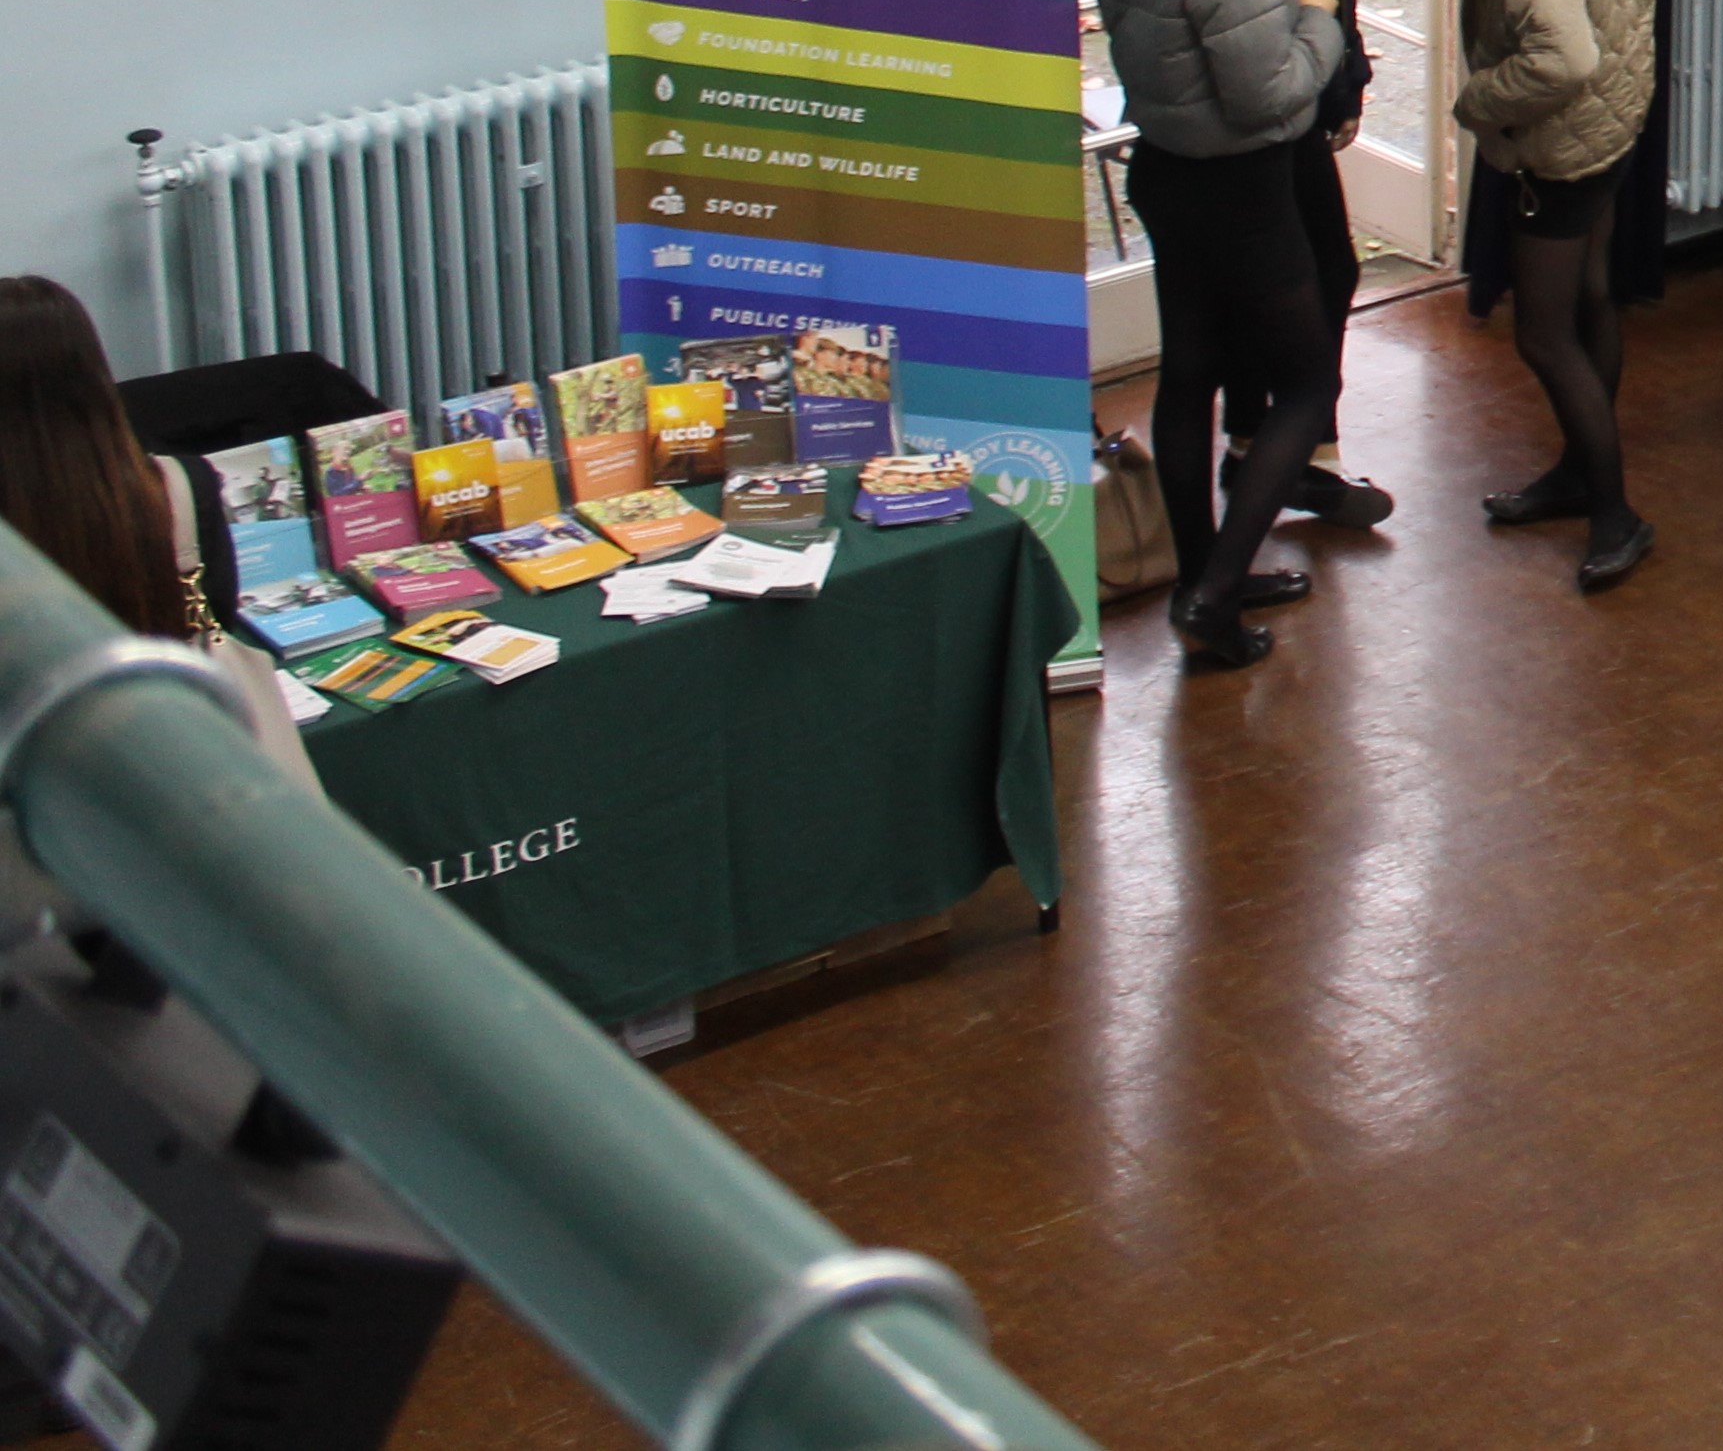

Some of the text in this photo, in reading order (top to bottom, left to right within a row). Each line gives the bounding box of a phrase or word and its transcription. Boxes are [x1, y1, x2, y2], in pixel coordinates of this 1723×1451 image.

[698, 32, 953, 79] FOUNDATION LEARNING
[700, 89, 866, 124] HORTICULTURE
[703, 143, 920, 182] LAND AND WILDLIFE
[705, 198, 779, 221] SPORT
[707, 252, 825, 280] OUTREACH
[710, 307, 790, 328] PUBLIC
[659, 420, 717, 444] ucab
[1005, 438, 1068, 507] LEARNING
[430, 478, 490, 507] ucab
